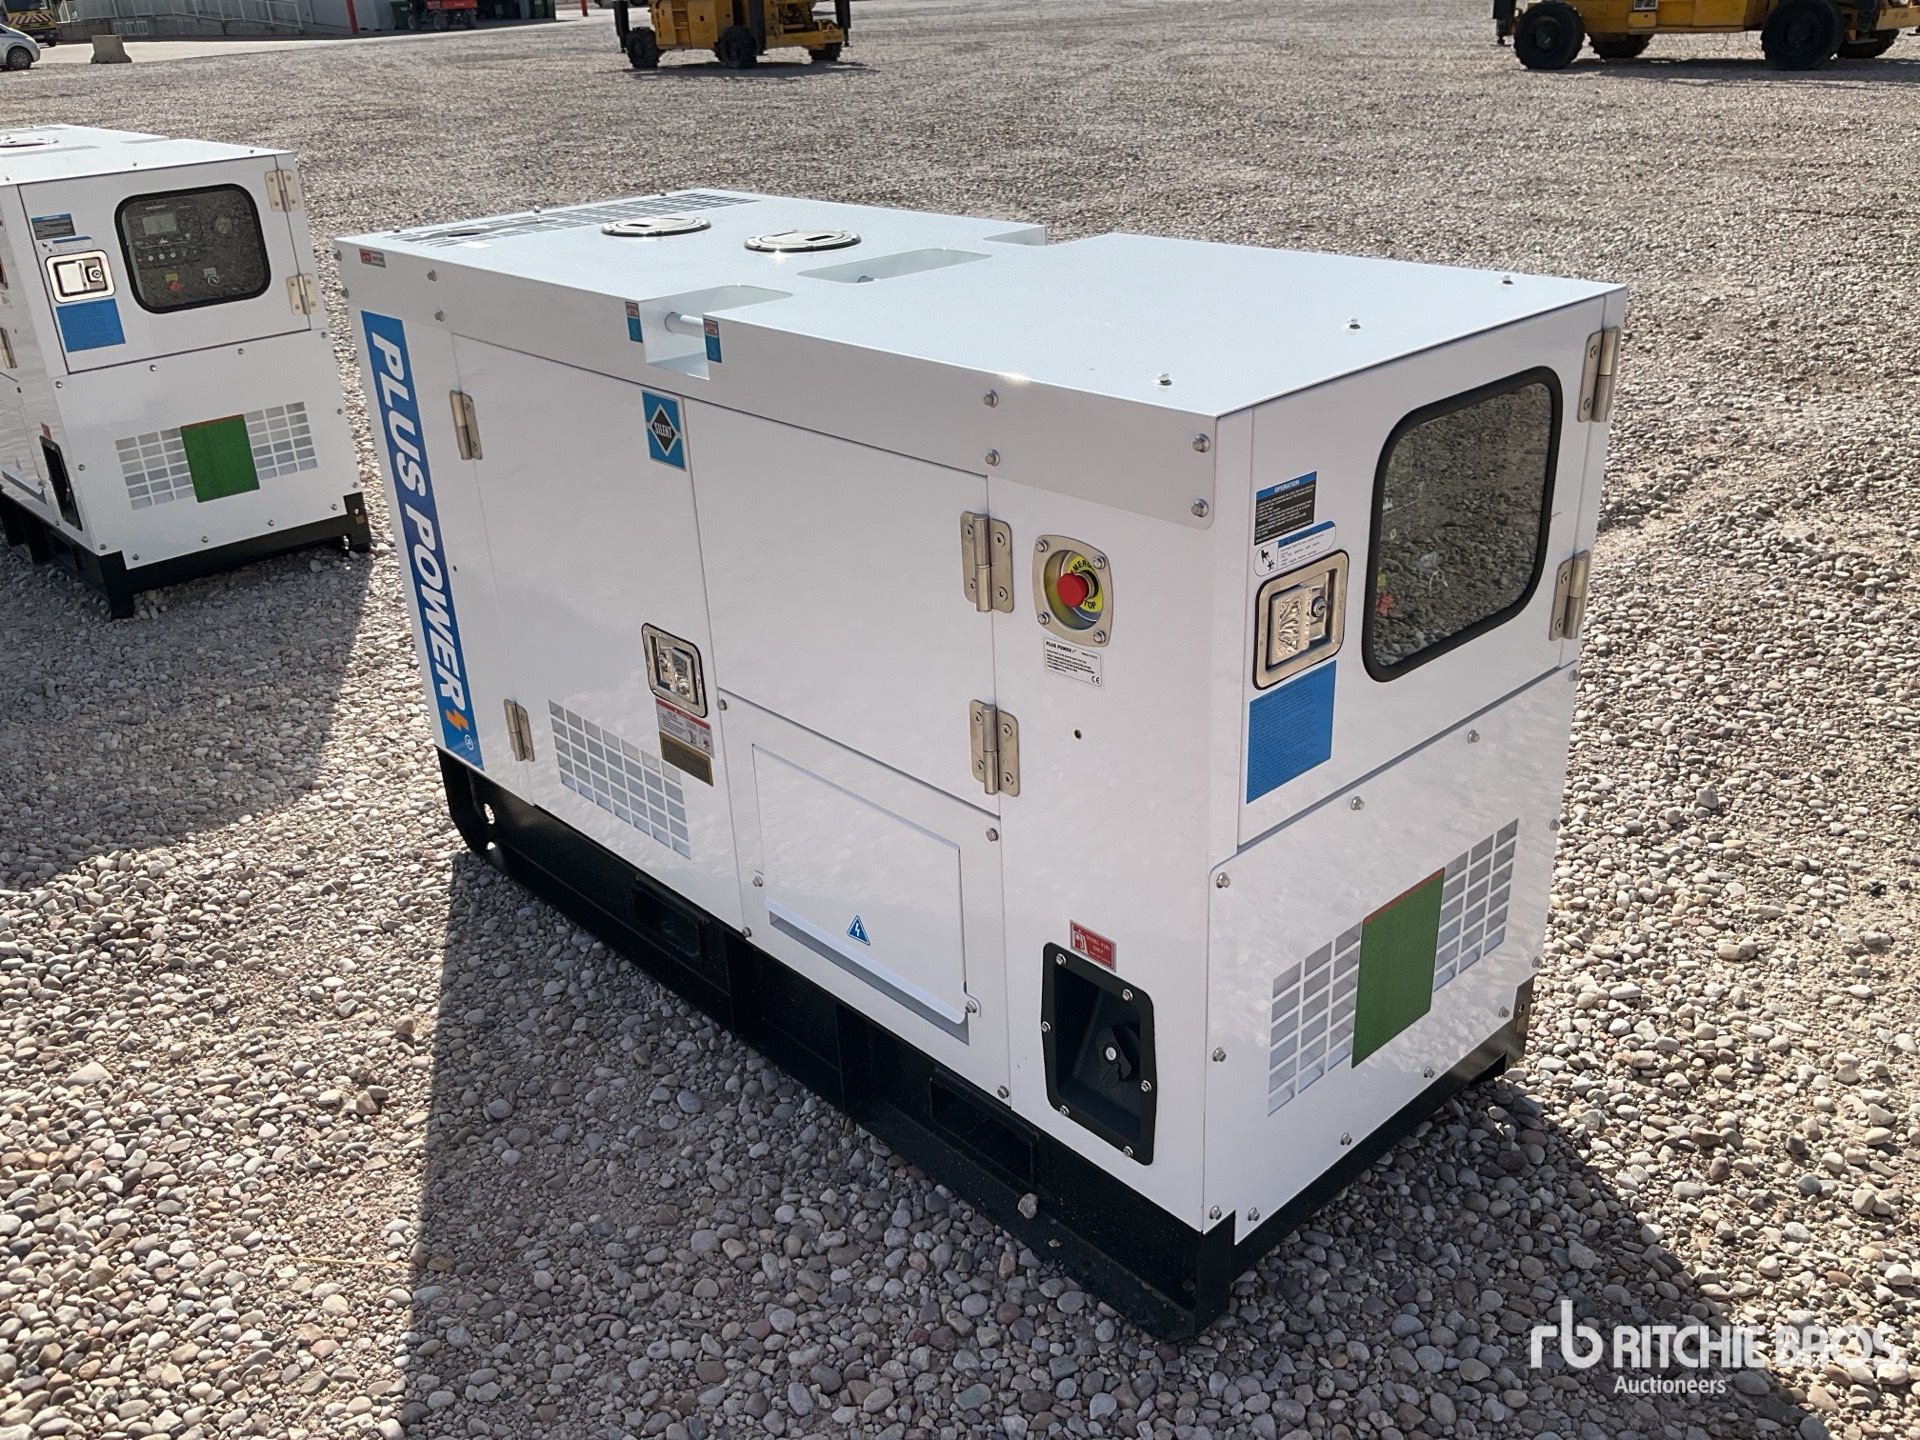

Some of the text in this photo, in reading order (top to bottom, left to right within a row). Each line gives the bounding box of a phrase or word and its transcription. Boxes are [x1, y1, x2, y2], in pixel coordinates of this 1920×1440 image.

[653, 421, 672, 439] SILENT
[1274, 479, 1300, 493] OPERATION
[371, 331, 427, 497] PLUS
[405, 503, 466, 711] POWER
[1084, 600, 1097, 610] TOP
